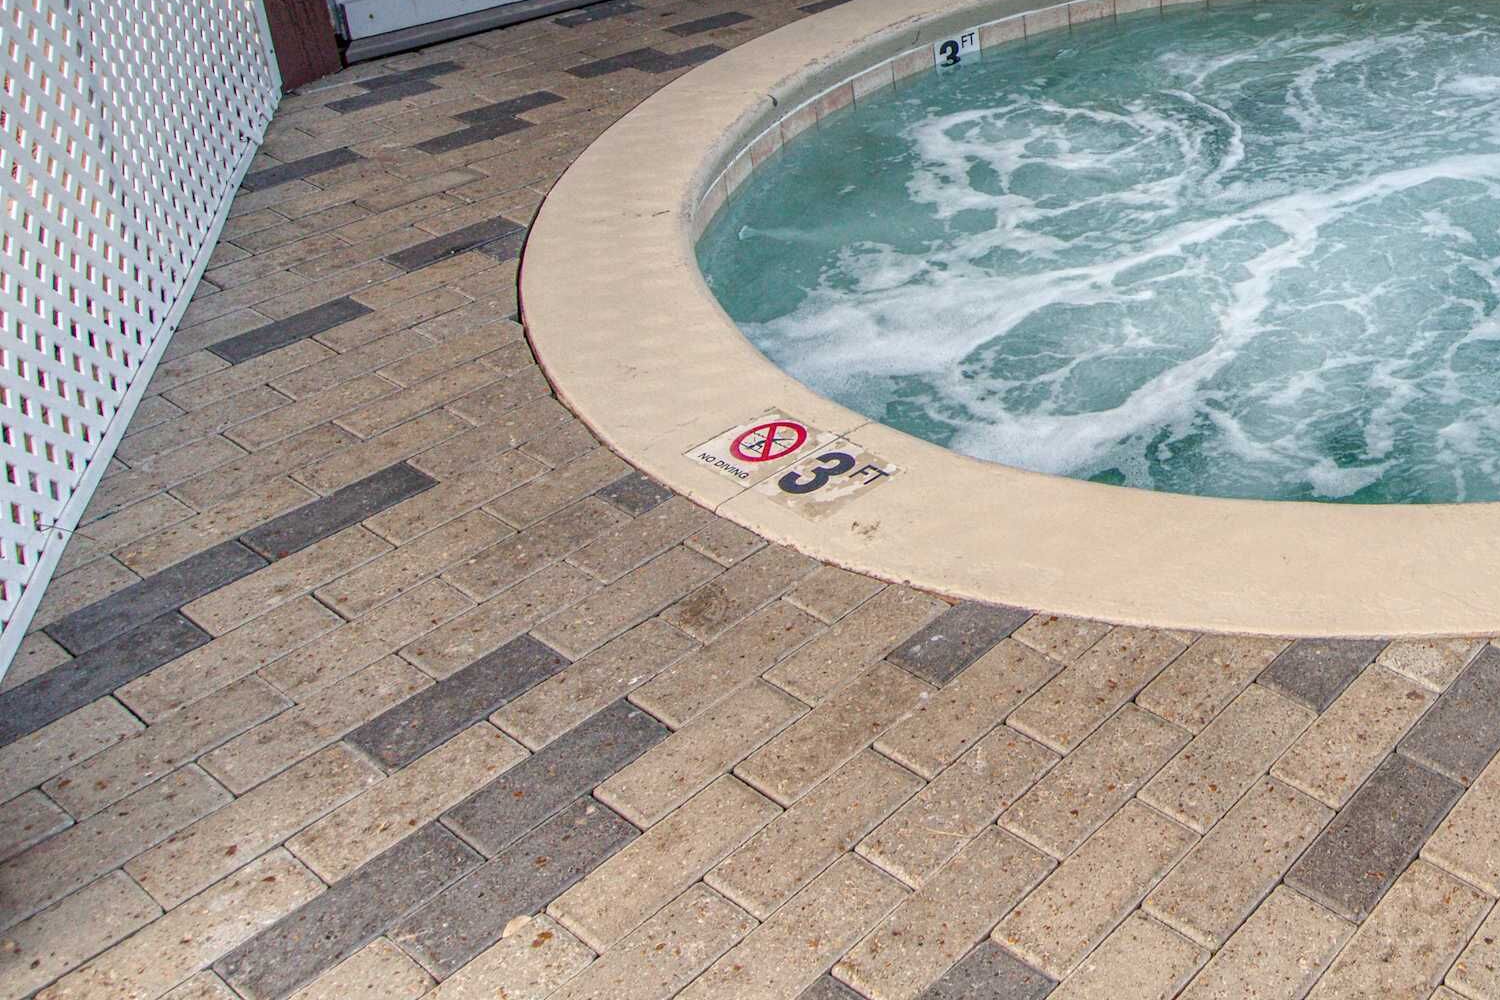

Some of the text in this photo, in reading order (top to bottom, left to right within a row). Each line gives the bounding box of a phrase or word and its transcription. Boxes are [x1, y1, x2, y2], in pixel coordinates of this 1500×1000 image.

[961, 32, 975, 48] FT
[698, 452, 749, 479] NO DIVING
[778, 452, 890, 494] 3 FT
